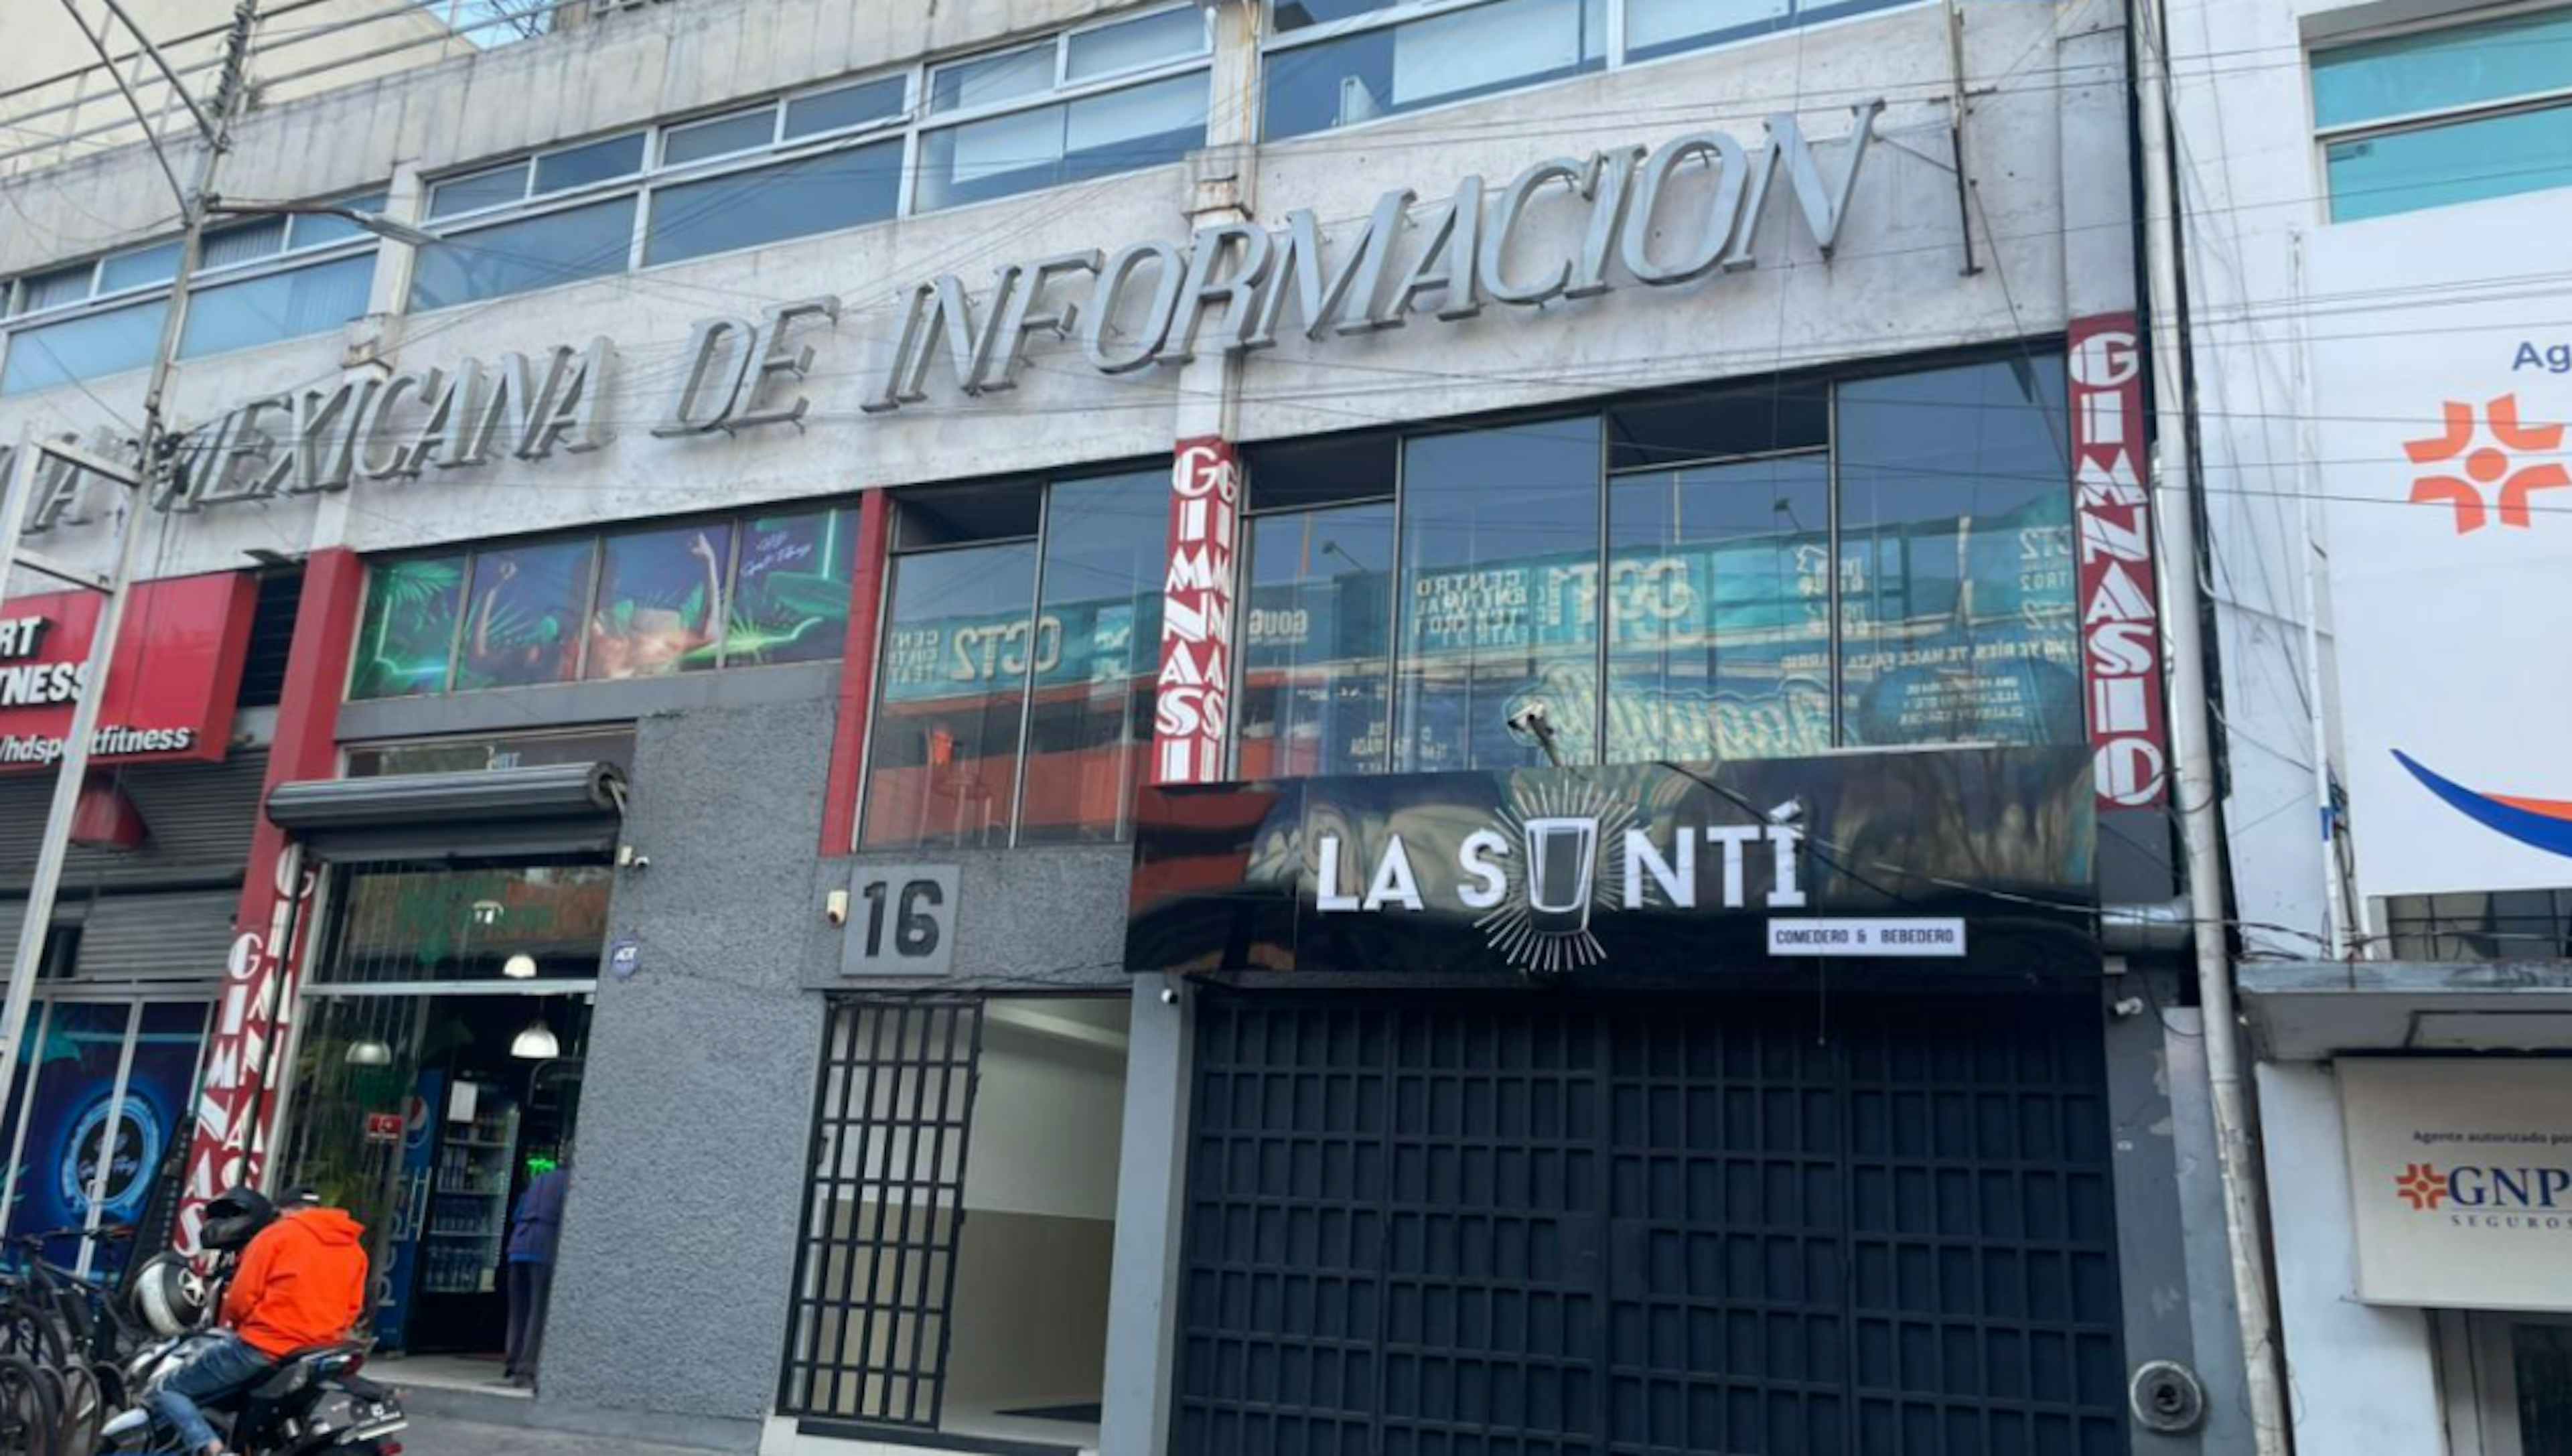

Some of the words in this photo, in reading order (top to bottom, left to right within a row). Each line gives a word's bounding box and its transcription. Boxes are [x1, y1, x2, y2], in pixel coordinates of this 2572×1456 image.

[650, 295, 841, 438] DE
[861, 98, 1885, 413] INFORMACION
[2070, 333, 2165, 805] GIMNASIO
[0, 660, 90, 706] NESS
[1316, 834, 1423, 912] LA
[863, 879, 944, 958] 16
[1776, 929, 1849, 944] COMEDERO
[1880, 928, 1954, 944] BEBEDERO
[2413, 1130, 2463, 1145] Agente
[2468, 1131, 2547, 1144] autorizado
[2449, 1165, 2571, 1208] GNP
